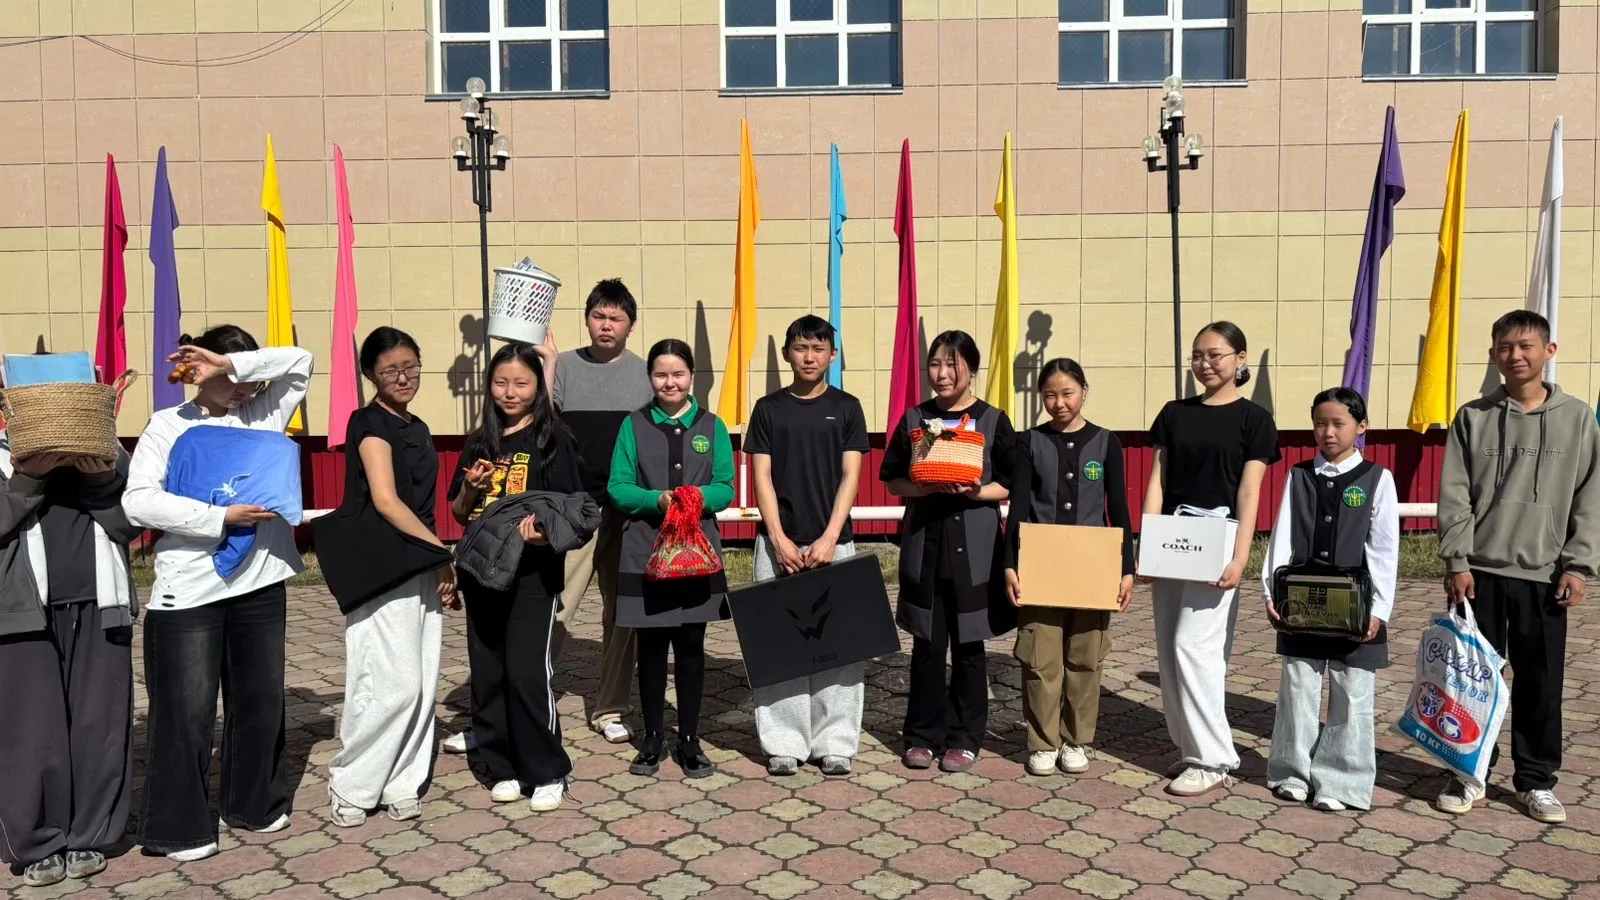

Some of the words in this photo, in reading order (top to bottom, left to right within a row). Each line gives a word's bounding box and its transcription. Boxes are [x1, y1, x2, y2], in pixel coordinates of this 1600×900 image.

[1162, 543, 1202, 552] COACH
[811, 652, 837, 664] NEO
[1426, 638, 1492, 682] САХАР
[1415, 729, 1427, 741] 10
